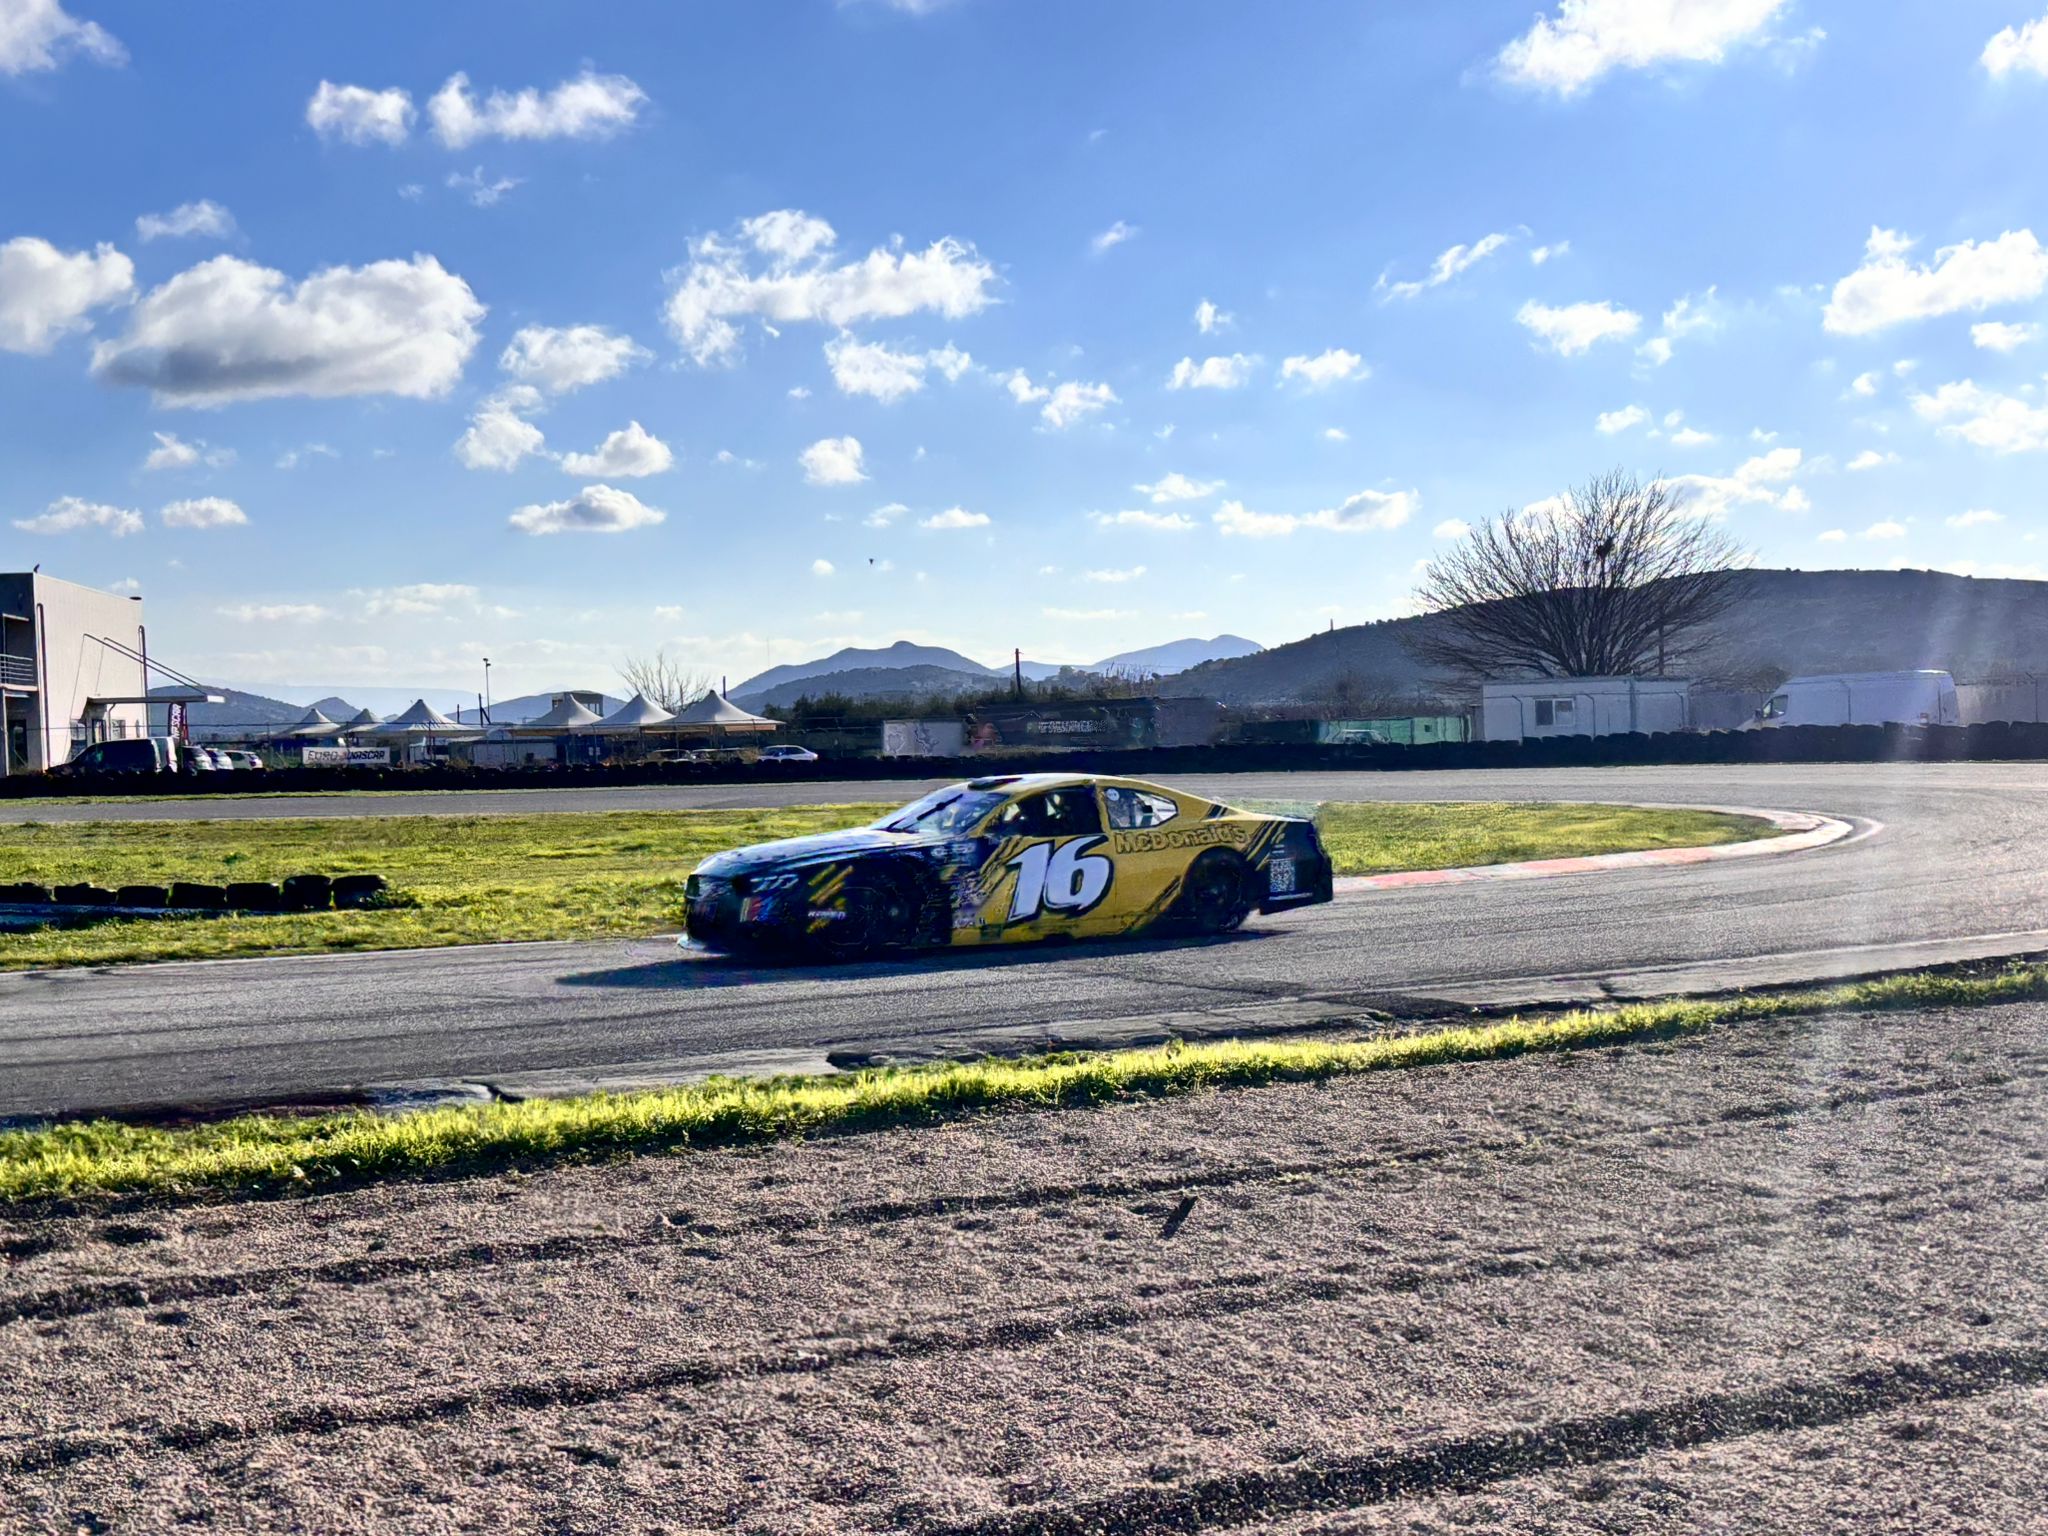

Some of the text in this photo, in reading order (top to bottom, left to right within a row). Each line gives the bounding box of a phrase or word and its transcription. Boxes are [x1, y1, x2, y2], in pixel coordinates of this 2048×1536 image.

[347, 750, 386, 760] NASCAR
[1114, 823, 1249, 854] McDonald's
[1004, 833, 1112, 923] 16
